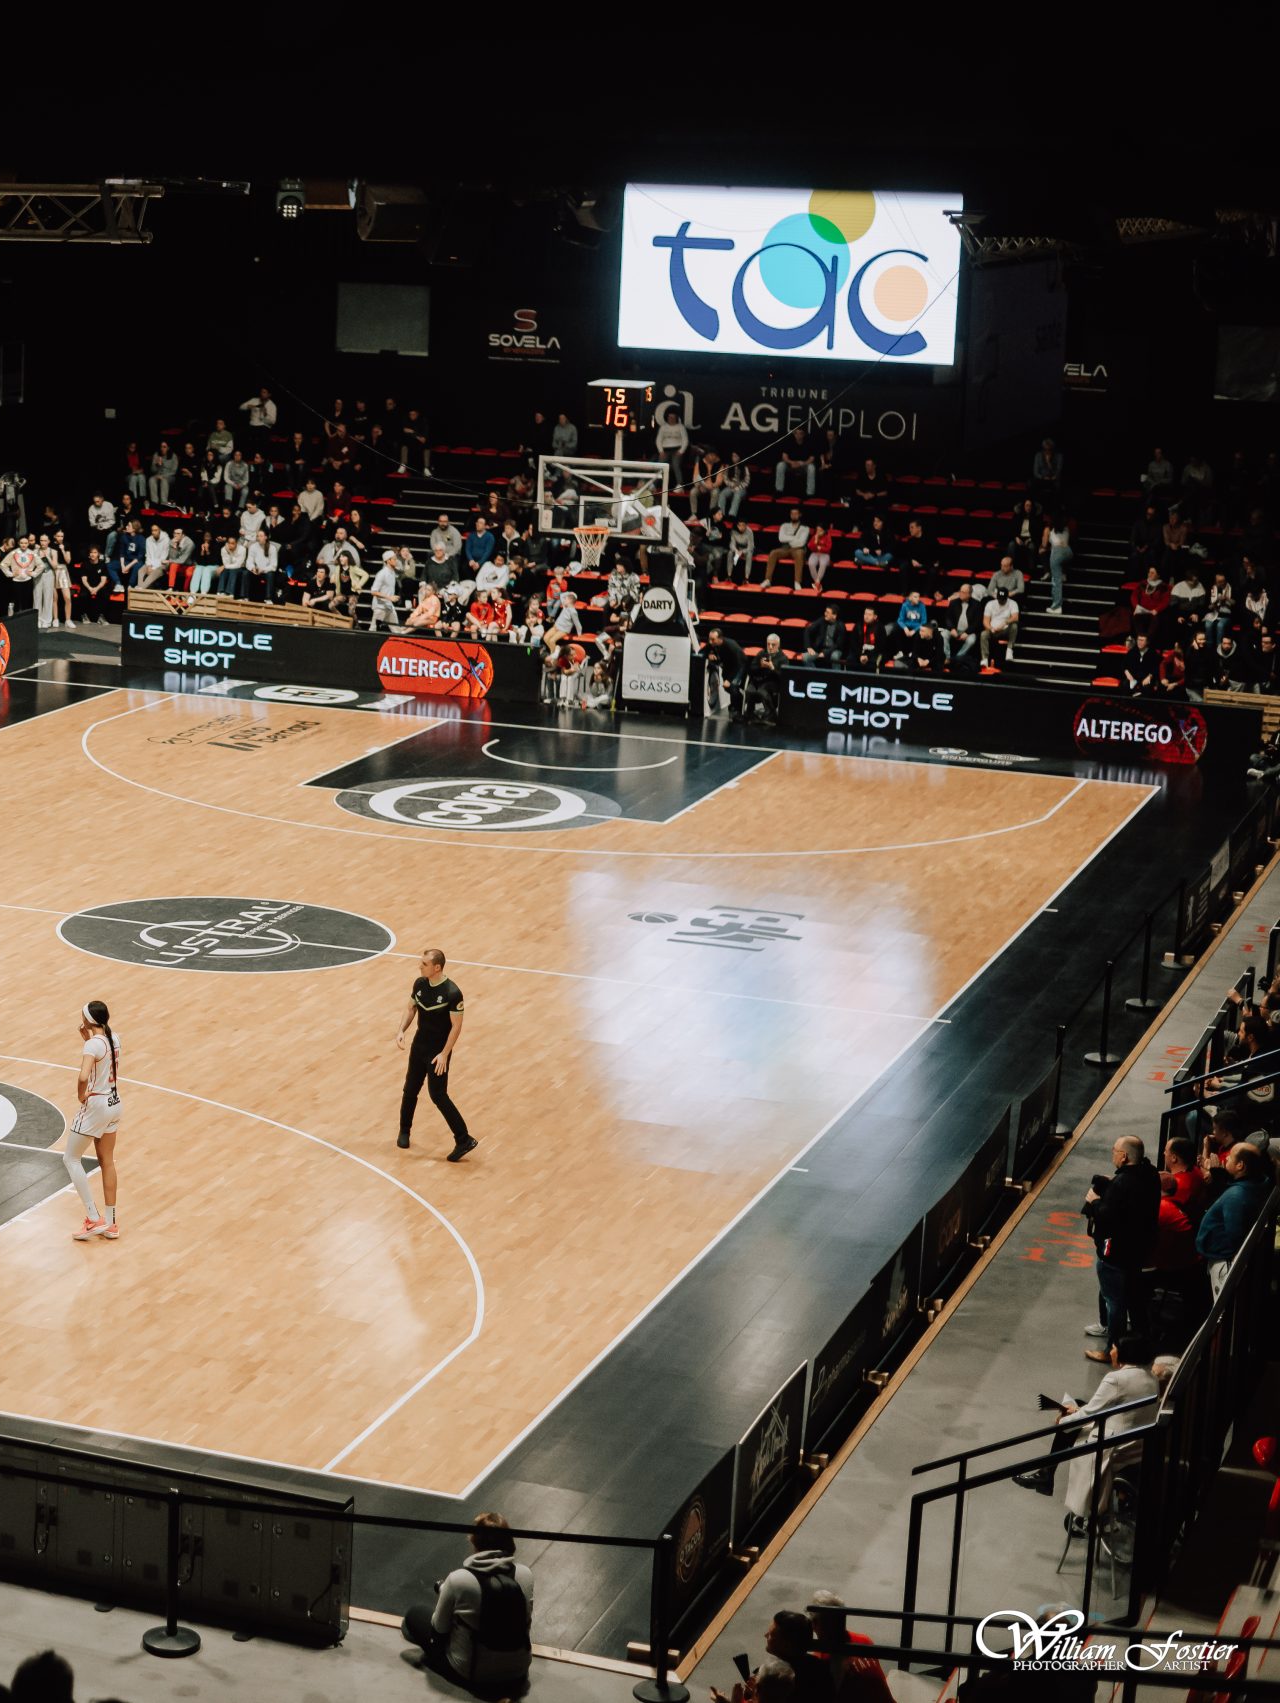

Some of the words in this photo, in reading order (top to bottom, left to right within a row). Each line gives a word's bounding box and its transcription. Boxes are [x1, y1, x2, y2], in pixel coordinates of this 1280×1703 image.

[652, 221, 929, 357] tac
[488, 333, 561, 349] SOVELA
[604, 388, 626, 404] 7.5
[760, 386, 828, 400] TRIBUNE
[605, 405, 629, 427] 16
[643, 600, 673, 611] DARTY
[129, 622, 163, 641] LE
[174, 627, 272, 651] MIDDLE
[164, 648, 236, 669] SHOT
[379, 655, 463, 681] ALTEREGO
[630, 679, 682, 694] GRASSO
[788, 679, 827, 700] LE
[841, 685, 953, 711] MIDDLE
[827, 707, 909, 730] SHOT
[1076, 717, 1172, 745] ALTEREGO
[417, 784, 539, 825] cora
[144, 903, 290, 966] LUSTRAL
